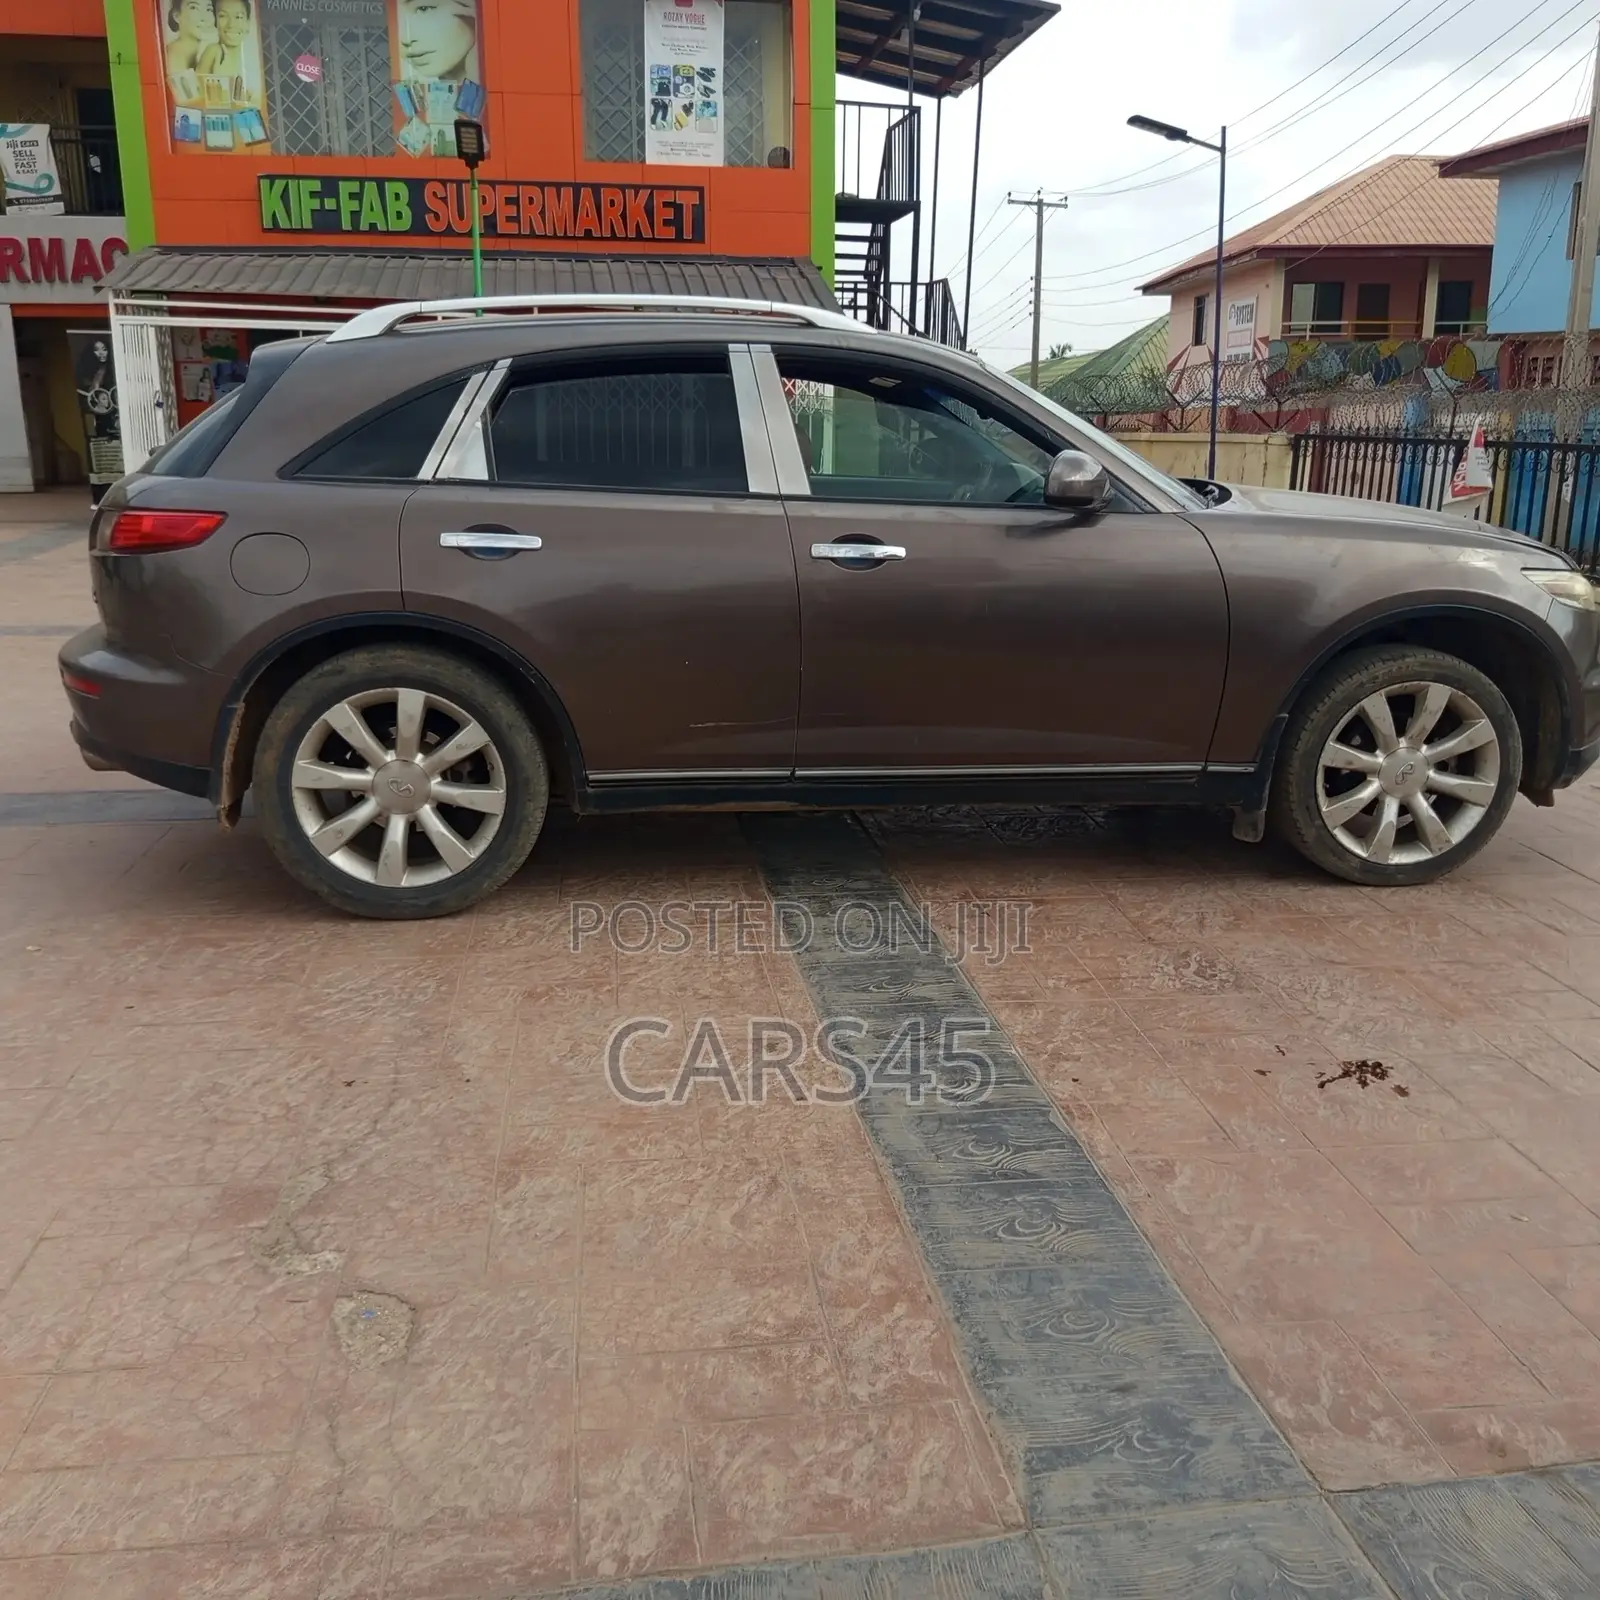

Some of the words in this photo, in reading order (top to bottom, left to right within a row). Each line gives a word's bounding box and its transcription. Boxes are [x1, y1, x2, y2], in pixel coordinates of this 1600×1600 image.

[318, 0, 383, 14] COSMETICS
[296, 63, 321, 75] CLOSE
[12, 149, 35, 158] SELL
[14, 161, 37, 169] FAST
[260, 178, 413, 232] KIF-FAB
[424, 181, 700, 240] SUPERMARKET
